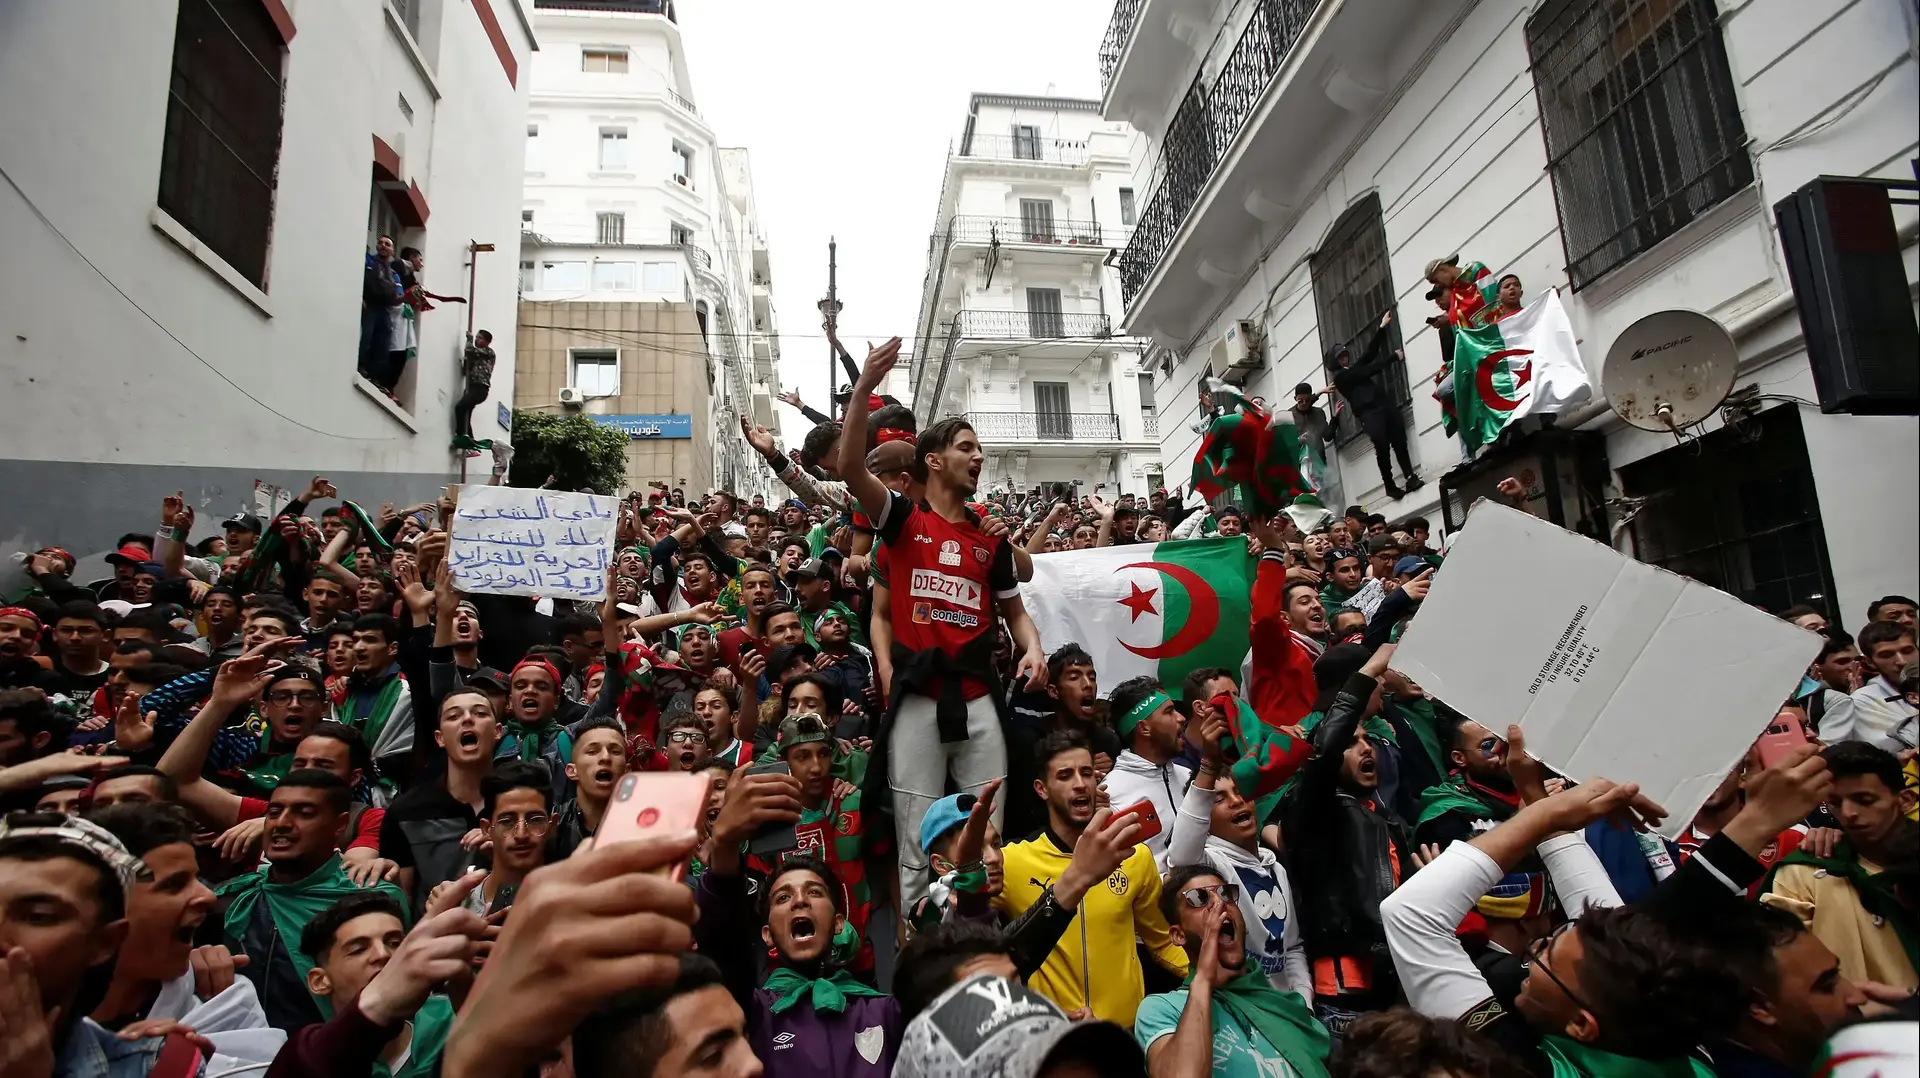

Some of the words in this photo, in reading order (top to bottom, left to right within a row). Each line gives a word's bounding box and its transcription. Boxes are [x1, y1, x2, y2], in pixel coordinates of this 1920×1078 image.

[1646, 335, 1693, 356] PACIFIC
[630, 424, 661, 436] كلودين
[458, 496, 549, 522] الشعب
[552, 496, 611, 523] نادي
[452, 529, 545, 548] للشعب
[555, 527, 604, 547] ملك
[534, 548, 607, 576] الحرية
[449, 567, 543, 588] المولودي
[914, 574, 964, 598] DJEZZY
[932, 609, 977, 626] sonelgaz
[1528, 677, 1542, 694] COLD
[1538, 650, 1559, 679] STORAGE
[1555, 604, 1588, 651] RECOMMENDED
[1547, 674, 1557, 684] TO
[1553, 651, 1571, 675] INSURE
[1567, 625, 1587, 653] QUALITY
[1564, 667, 1573, 677] 32
[1569, 658, 1579, 668] TO
[1575, 648, 1585, 659] 40°
[1576, 668, 1586, 678] TO
[1582, 652, 1595, 669] 4.44°
[1131, 696, 1156, 715] VIVA
[1109, 872, 1127, 888] BVB
[773, 1043, 794, 1051] umbro
[1212, 1024, 1240, 1073] NEW
